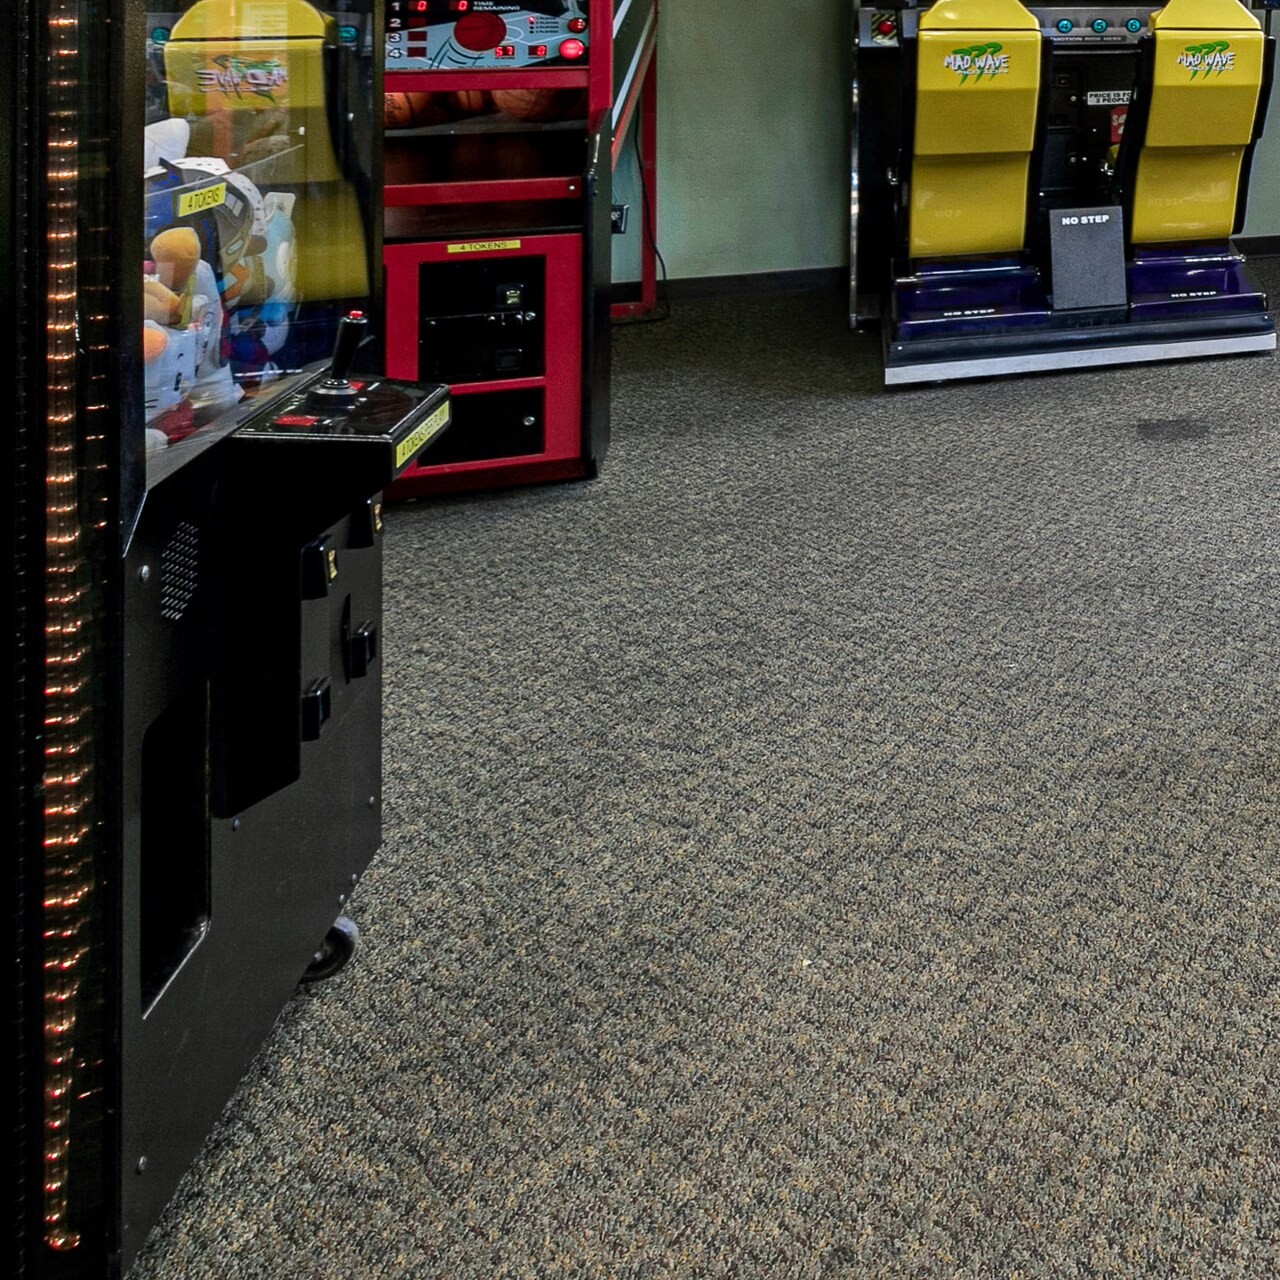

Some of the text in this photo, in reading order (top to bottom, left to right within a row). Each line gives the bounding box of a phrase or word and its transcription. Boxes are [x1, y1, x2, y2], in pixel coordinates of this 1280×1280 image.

[944, 53, 1010, 71] MAD WAVE
[1177, 51, 1236, 67] MAD WAVE
[1051, 214, 1110, 226] NO STEP
[469, 242, 508, 250] TOKENS
